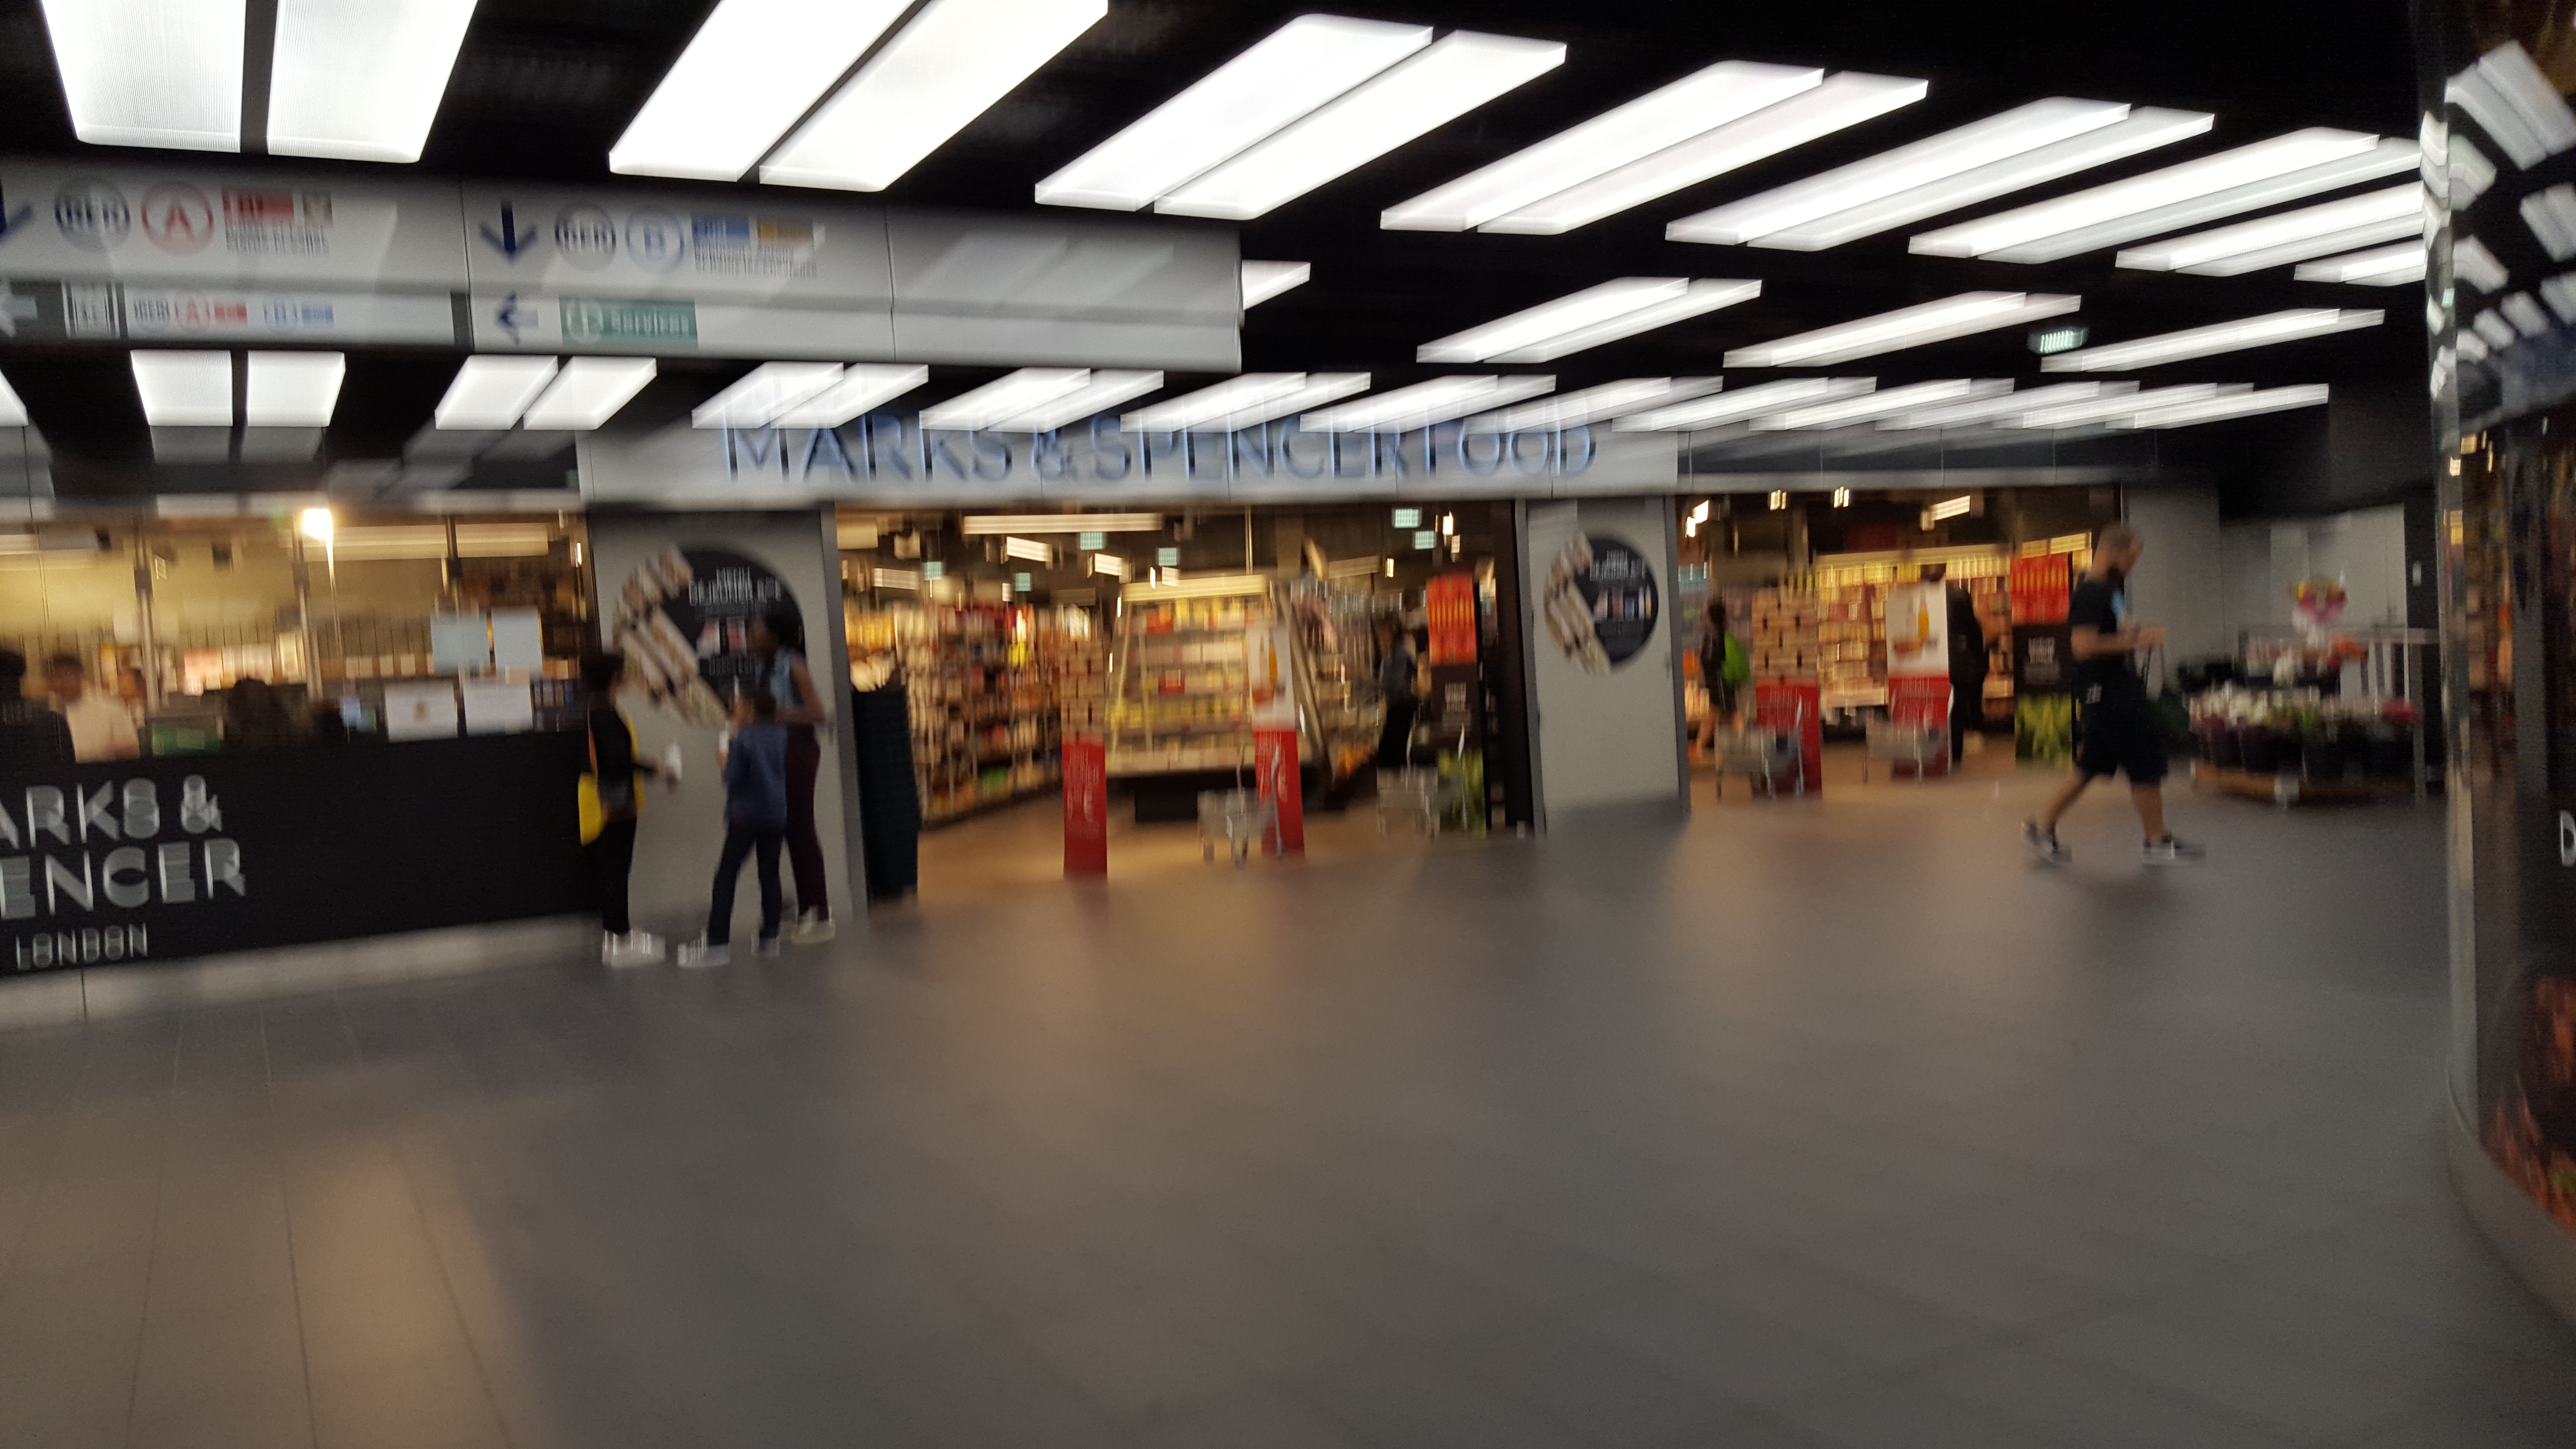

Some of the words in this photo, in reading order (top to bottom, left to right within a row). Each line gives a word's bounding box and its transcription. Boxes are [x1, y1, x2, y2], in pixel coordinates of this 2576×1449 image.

[723, 411, 1014, 482] MARKS
[1031, 420, 1078, 481] &
[1088, 412, 1409, 480] SPENCER
[1423, 412, 1598, 478] FOOD
[180, 774, 223, 835] &
[0, 837, 247, 919] ENCER
[16, 922, 148, 970] LONDON
